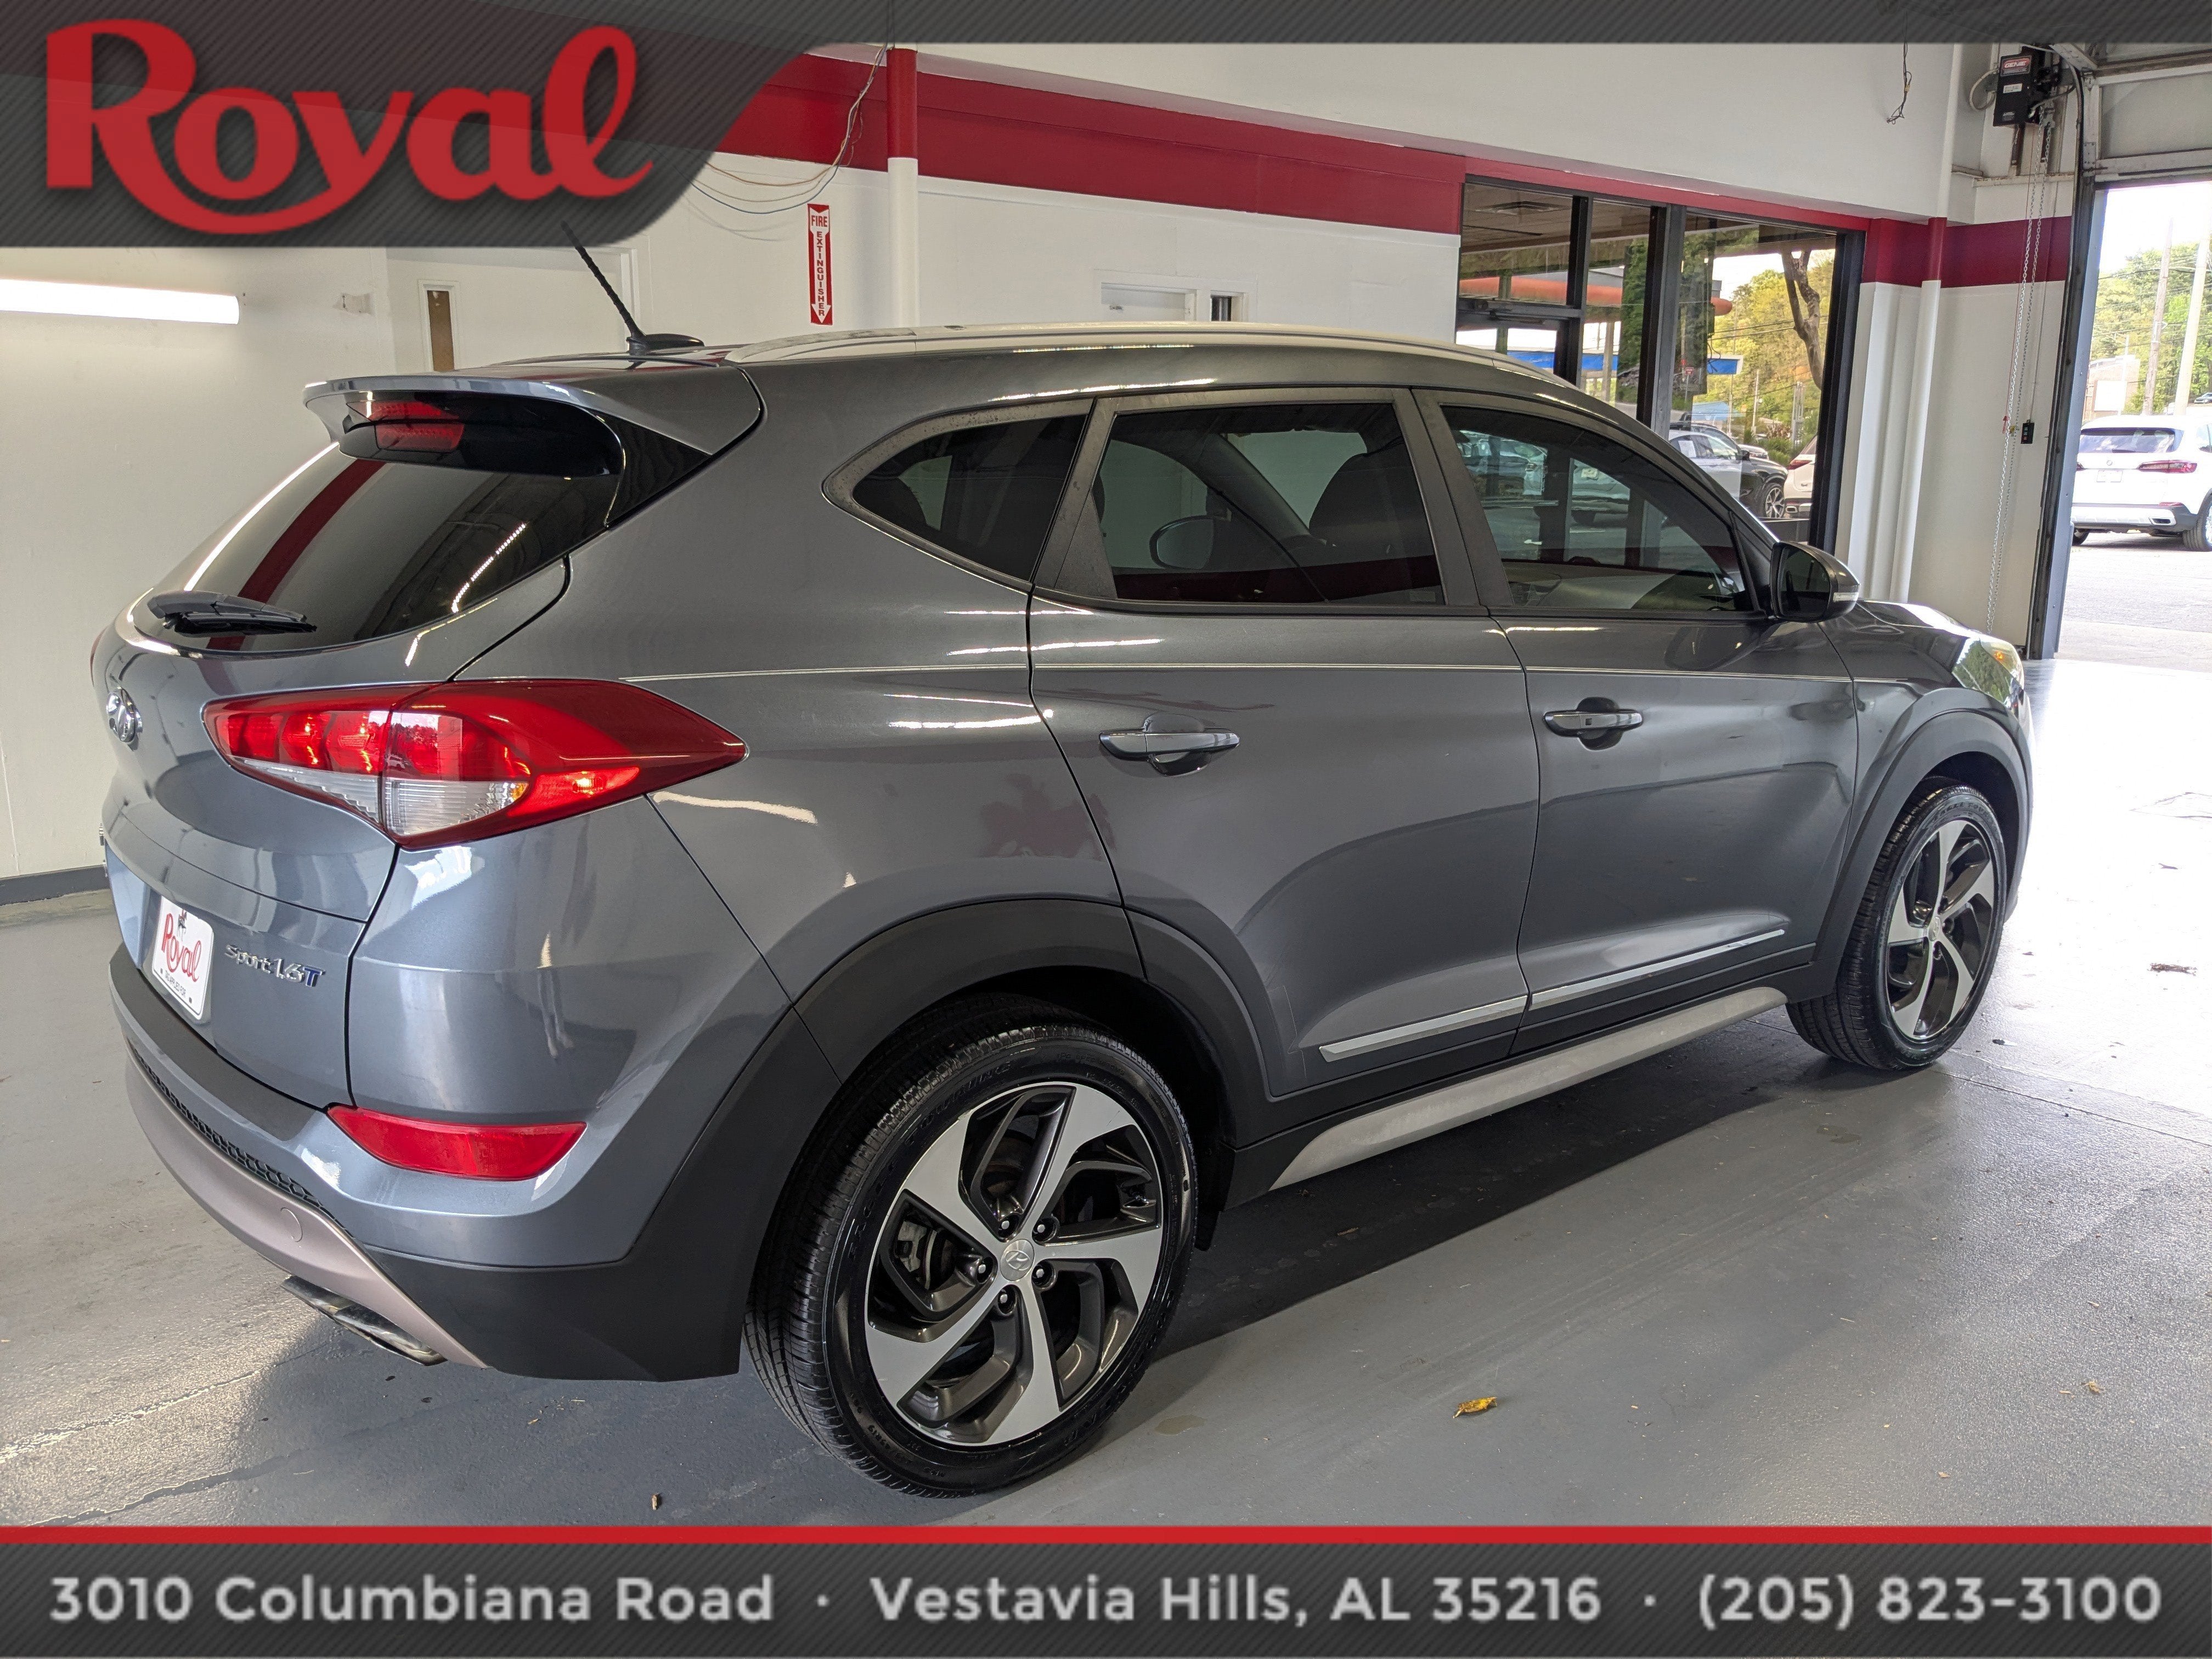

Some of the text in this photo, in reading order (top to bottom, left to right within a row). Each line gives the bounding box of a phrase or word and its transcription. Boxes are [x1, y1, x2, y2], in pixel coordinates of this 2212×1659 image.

[811, 215, 828, 228] FIRE
[816, 231, 825, 317] EXTINGUISHER
[161, 913, 202, 983] Royal
[224, 944, 326, 988] Sport 1.6T
